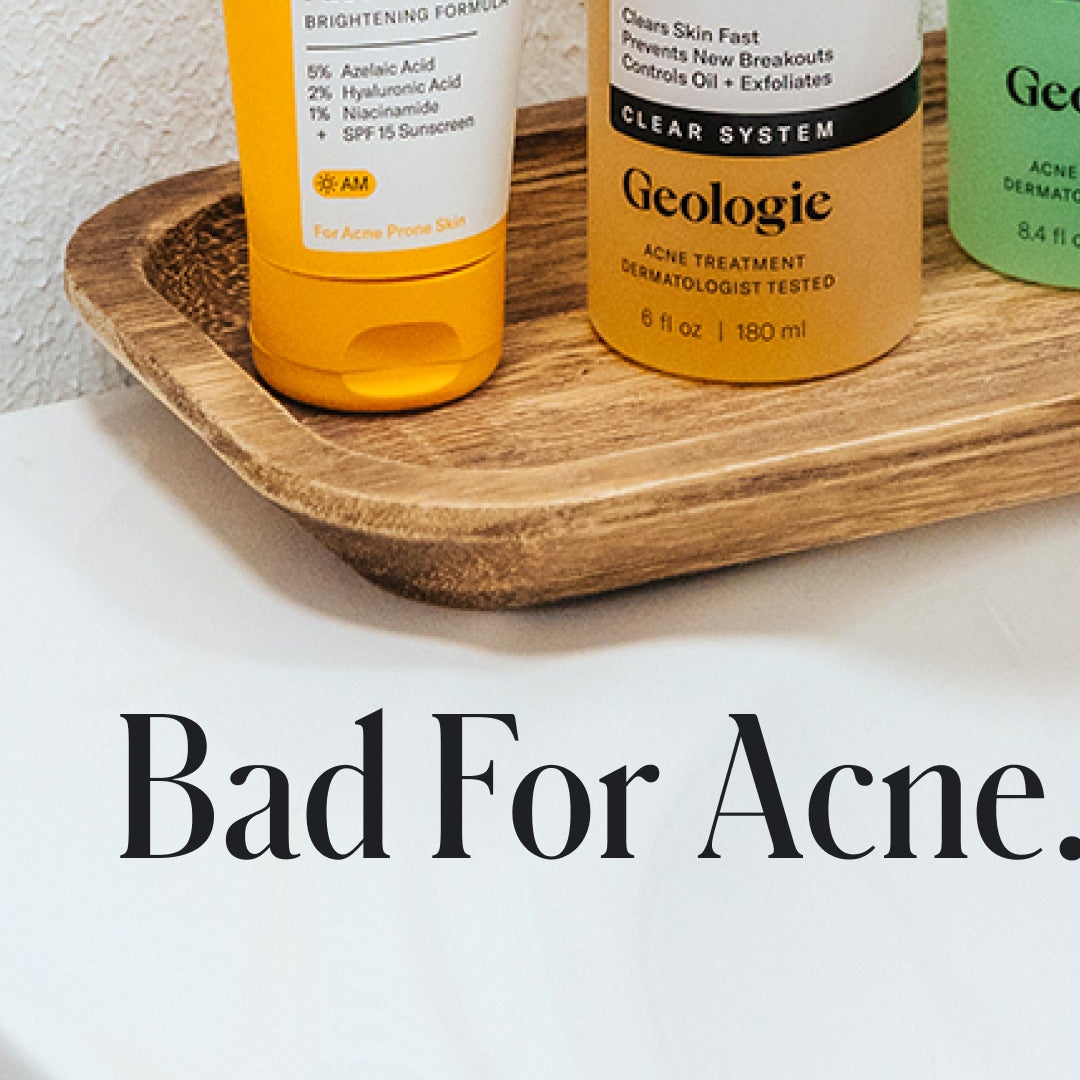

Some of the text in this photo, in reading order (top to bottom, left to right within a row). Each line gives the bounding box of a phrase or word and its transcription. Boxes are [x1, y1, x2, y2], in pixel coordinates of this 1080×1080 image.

[304, 7, 429, 30] BRIGHTENING
[621, 6, 760, 46] Clears Skin Fast
[621, 29, 835, 69] Prevents New Breakouts
[307, 56, 436, 81] 5% Azelaic Acid
[621, 52, 833, 93] Controls Oil + Exfoliates
[307, 73, 462, 103] 2% Hyaluronic Acid
[309, 100, 439, 122] 1% Niacinamide
[620, 105, 835, 145] CLEAR SYSTEM
[342, 125, 375, 143] SPF
[378, 124, 396, 140] 15
[399, 114, 475, 139] Sunscreen
[340, 176, 369, 192] AM
[1029, 159, 1077, 181] ACNE
[622, 167, 834, 237] Geologie
[314, 214, 467, 241] For Acne Prone Skin
[1017, 221, 1046, 244] 8.4
[1052, 224, 1067, 246] fl
[643, 243, 806, 272] ACNE TREATMENT
[620, 258, 837, 295] DERMATOLOGIST TESTED
[641, 307, 653, 329] 6
[659, 311, 673, 334] fl
[678, 322, 703, 339] oz
[736, 321, 776, 343] 180
[781, 319, 807, 339] ml
